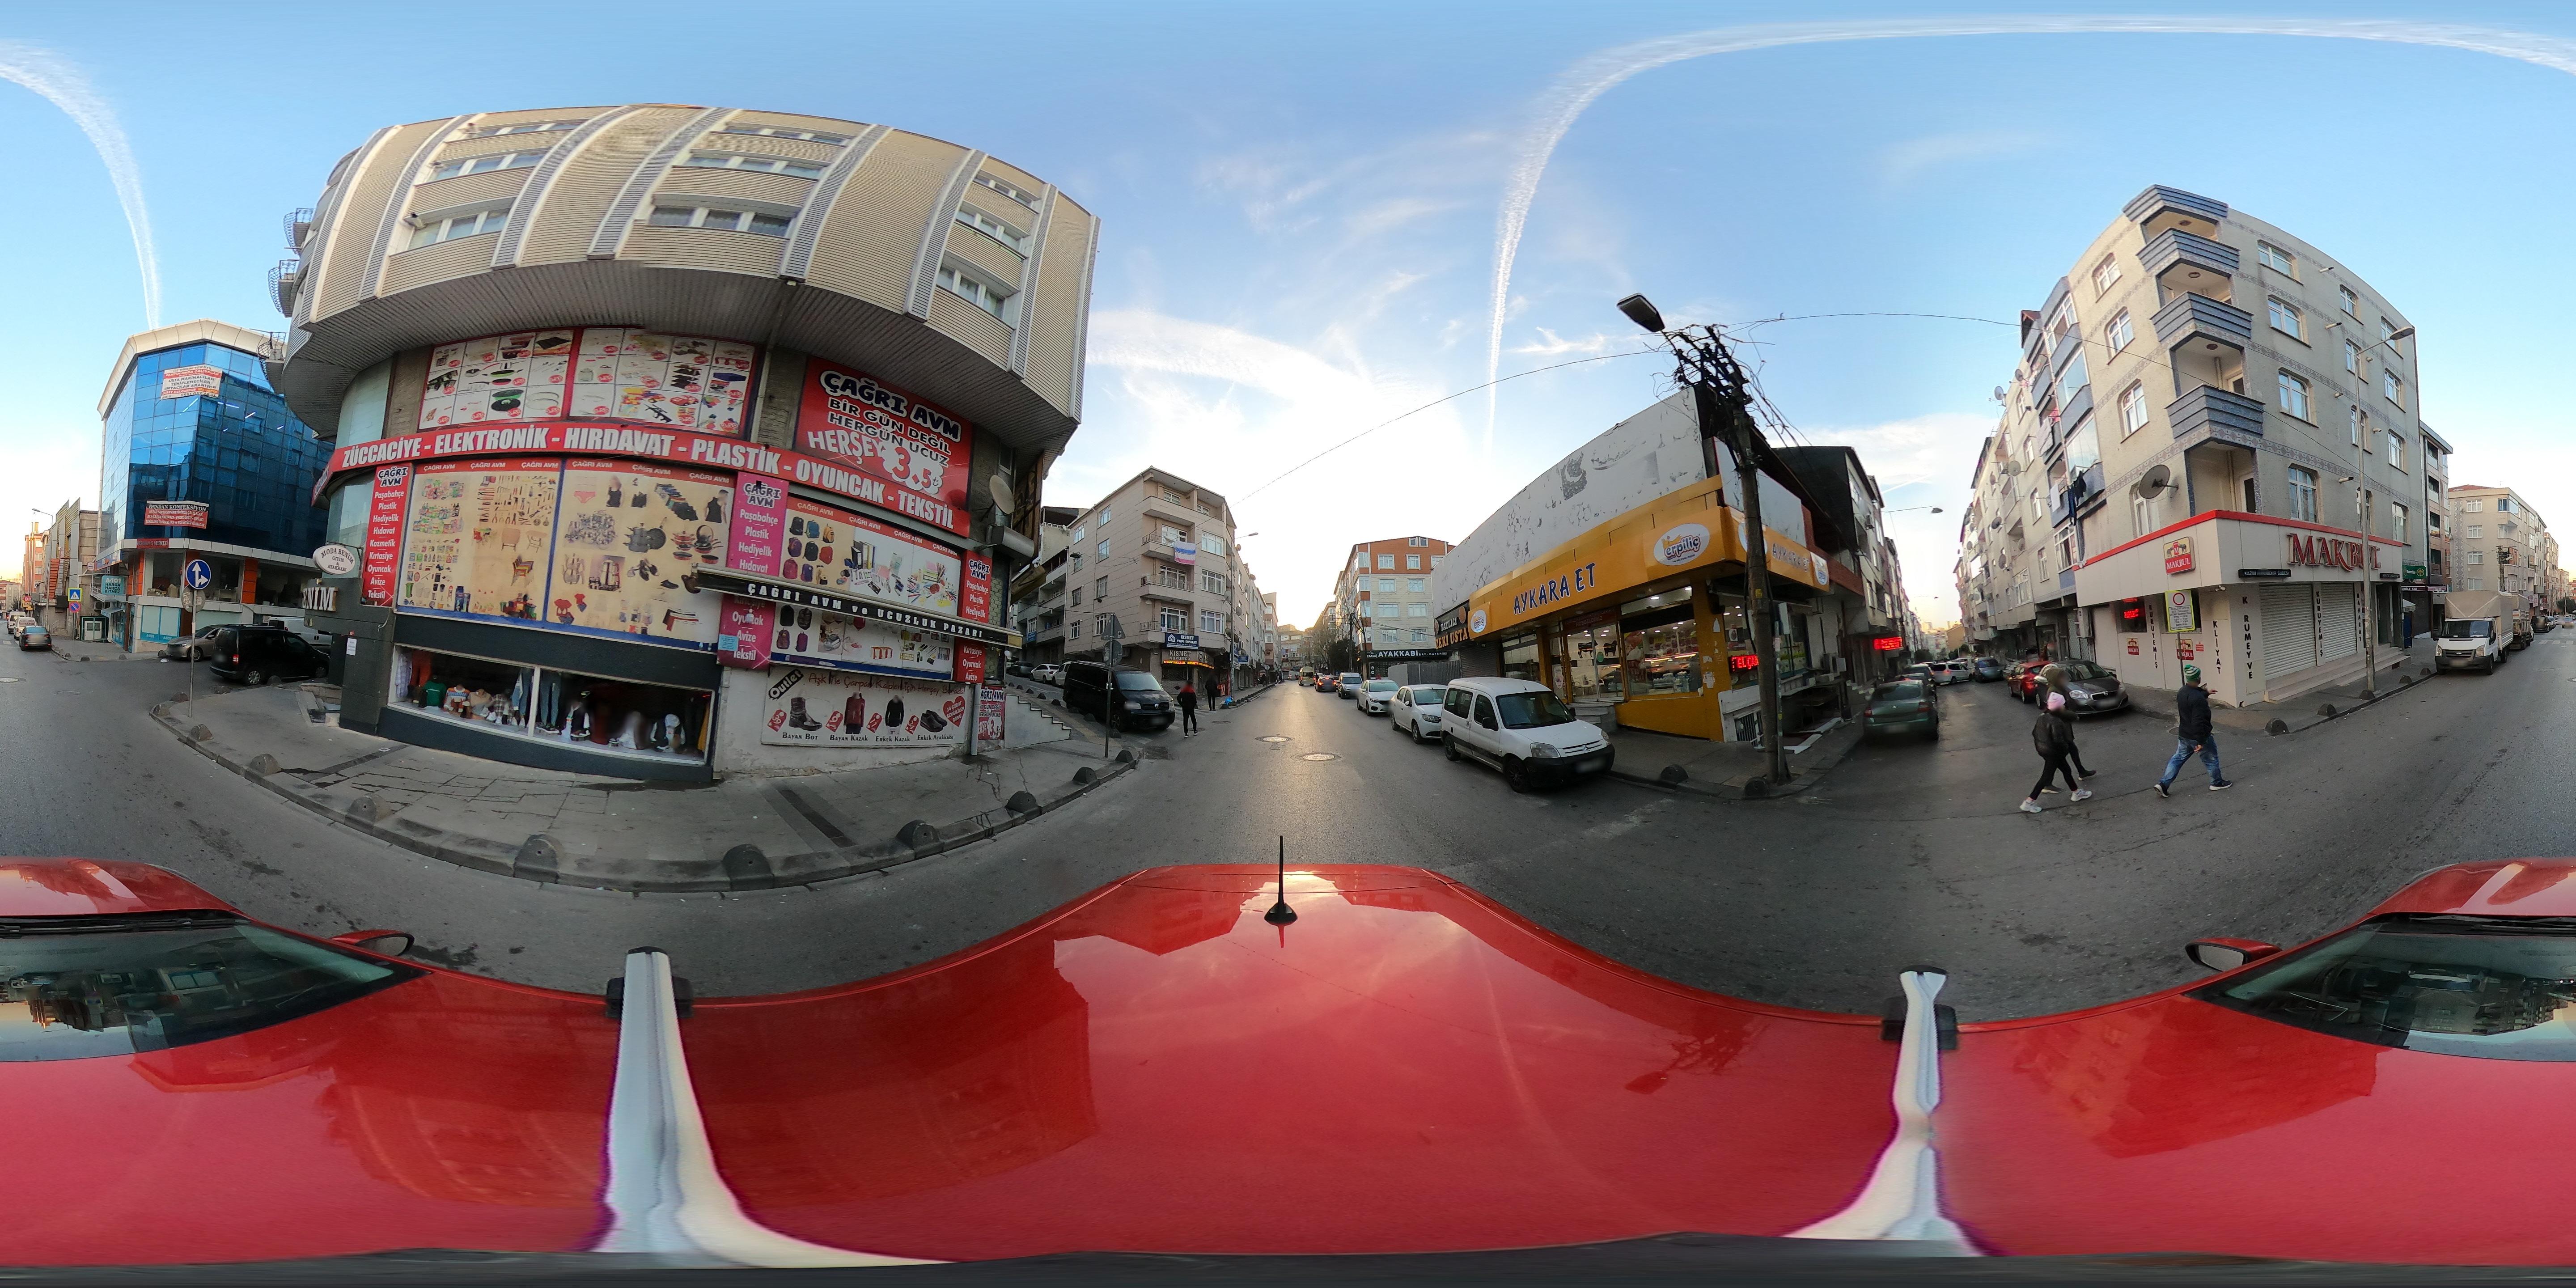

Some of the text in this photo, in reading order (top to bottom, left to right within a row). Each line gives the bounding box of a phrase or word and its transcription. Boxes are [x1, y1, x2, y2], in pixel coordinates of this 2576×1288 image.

[823, 372, 961, 441] ÇAĞRI AVM
[829, 397, 951, 455] BİR GÜN DEĞİL
[829, 412, 950, 467] HERGÜN UCUZ
[807, 429, 884, 464] HERŞEY
[572, 460, 595, 468] ÇAĞRI
[341, 424, 954, 530] ZÜCCACİYE ELEKTRONİK HIRDAVAT PLASTİK OYUNCAK TEKSTİL
[377, 466, 408, 479] ÇAĞRI
[689, 472, 729, 483] ÇAĞRI AVM
[381, 477, 402, 487] AVM
[374, 490, 405, 499] Paşabahçe
[744, 482, 781, 499] ÇAĞRI
[748, 495, 774, 508] AVM
[797, 502, 834, 517] ÇAĞRI AVM
[373, 514, 399, 523] Hediyelik
[740, 509, 779, 527] Paşabahçe
[849, 516, 868, 526] ÇAĞRI
[745, 526, 770, 540] Plastik
[894, 530, 923, 544] ÇAĞRI AVM
[369, 539, 396, 547] Kozmetik
[738, 542, 772, 557] Hediyelik
[932, 543, 947, 553] ÇAĞRI
[1665, 536, 1700, 556] erpiliç
[321, 548, 354, 565] MODA BENİM
[369, 551, 393, 560] Kırtasiye
[368, 564, 391, 573] Oyuncak
[969, 559, 990, 573] ÇAĞRI
[2166, 557, 2191, 570] MAKBUL
[971, 569, 987, 580] AVM
[370, 578, 386, 586] Avize
[966, 580, 989, 595] Paşabahçe
[1513, 574, 1571, 615] AYKARA
[1574, 562, 1596, 593] ET
[368, 590, 386, 599] Tekstil
[970, 594, 984, 605] Plastik
[747, 583, 983, 638] ÇAĞRI AVM ve UCUZLUK PAZARI
[966, 606, 986, 619] Hediyelik
[732, 611, 764, 626] Oyuak
[1440, 616, 1457, 631] TATLICI
[737, 630, 757, 642] Avize
[1435, 627, 1468, 649] ZEKİ USTA
[963, 645, 983, 656] Kırtasiye
[962, 658, 981, 669] Oyuncak
[965, 672, 978, 681] Avize
[769, 669, 803, 699] Outlet
[980, 687, 1004, 701] AĞRI AVM
